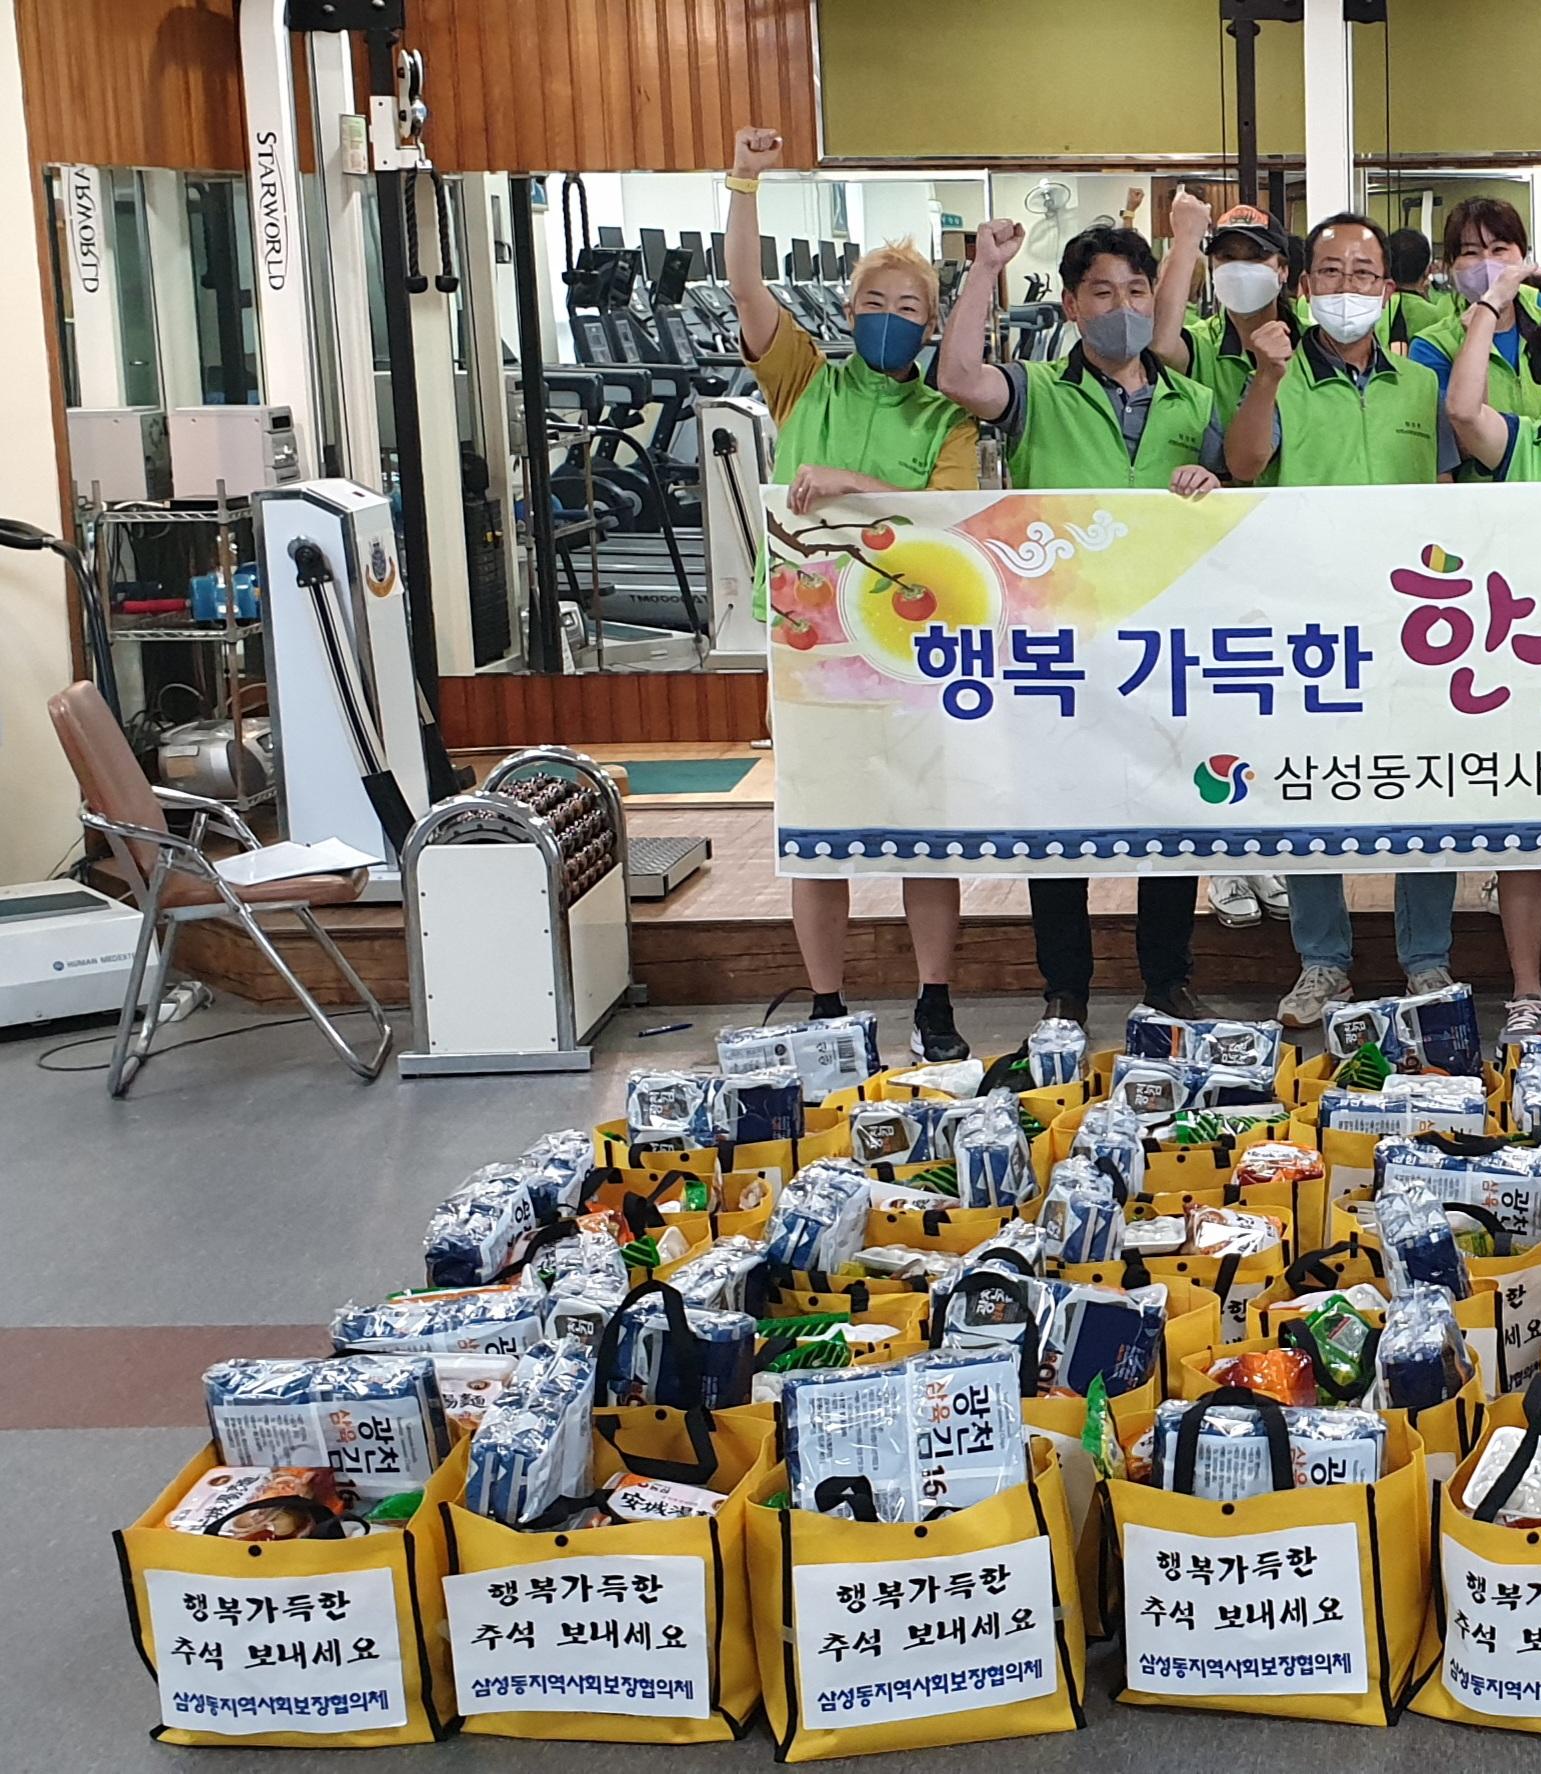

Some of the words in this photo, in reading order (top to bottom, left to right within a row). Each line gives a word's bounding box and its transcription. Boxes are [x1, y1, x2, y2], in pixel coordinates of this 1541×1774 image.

[256, 131, 287, 291] STARWORLD
[914, 626, 1085, 720] 행복
[1117, 624, 1373, 717] 가득한
[926, 1381, 951, 1424] 삼육
[953, 1384, 995, 1456] 광천
[328, 1409, 357, 1443] 삼육
[916, 1426, 954, 1460] 김
[327, 1446, 364, 1474] 김
[357, 1415, 401, 1474] 광천
[1157, 1546, 1317, 1585] 행복가득한
[488, 1574, 663, 1606] 행복가득한
[837, 1564, 1011, 1613] 행복가득한
[183, 1591, 350, 1626] 행복가득한
[1141, 1596, 1194, 1630] 추석
[1215, 1597, 1343, 1630] 보내세요
[471, 1621, 534, 1650] 추석
[557, 1619, 687, 1650] 보내세요
[818, 1629, 881, 1662] 추석
[904, 1609, 1035, 1650] 보내세요
[1454, 1610, 1495, 1653] 추석
[172, 1637, 223, 1671] 추석
[245, 1638, 379, 1669] 보내세요
[1140, 1653, 1351, 1679] 삼성동지역사회보장협의체
[472, 1675, 693, 1699] 삼성동지역사회보장협의체
[818, 1659, 1044, 1712] 삼성동지역사회보장협의체
[173, 1690, 388, 1717] 삼성동지역사회보장협의체
